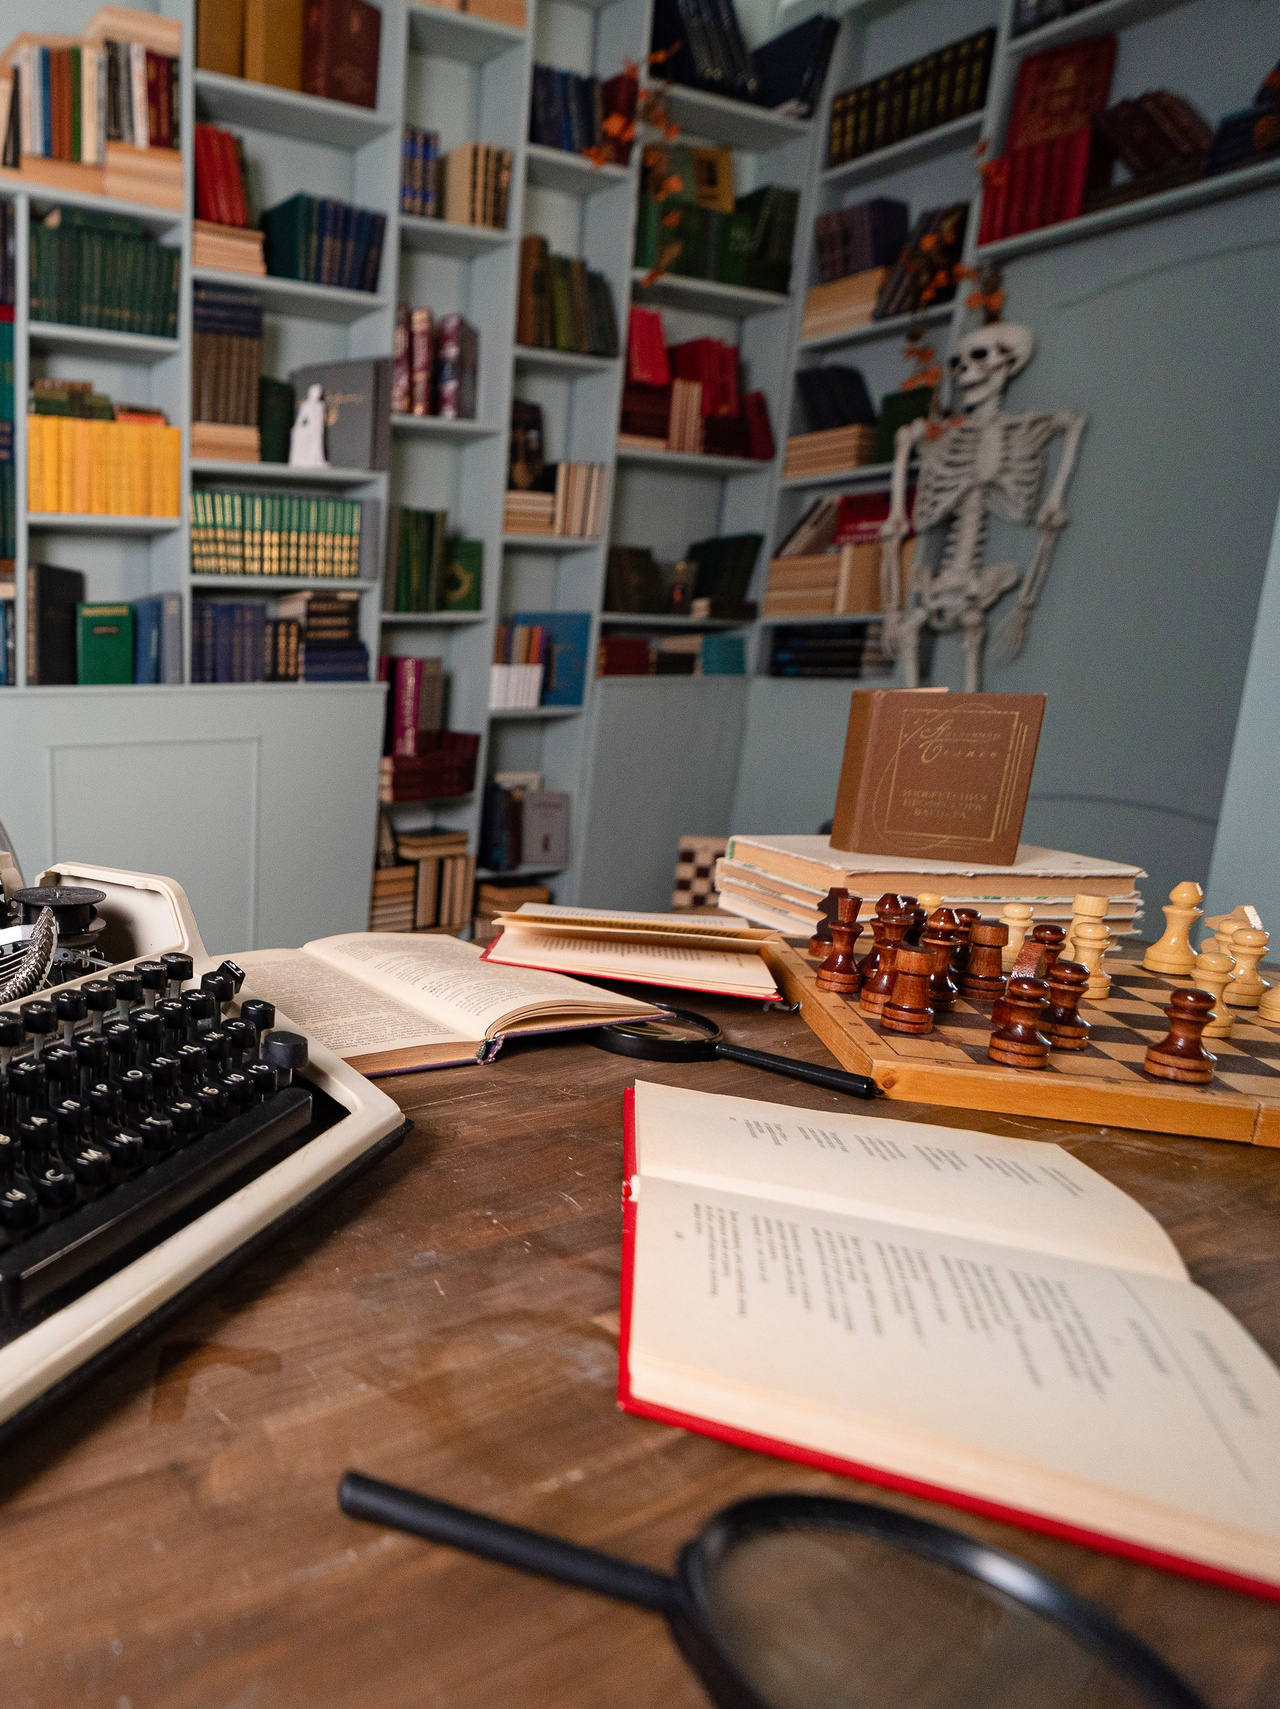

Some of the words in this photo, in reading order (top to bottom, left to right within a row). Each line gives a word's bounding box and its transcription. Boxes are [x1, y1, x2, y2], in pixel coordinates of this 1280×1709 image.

[111, 1023, 129, 1032] Ш
[205, 1031, 224, 1040] Ж
[50, 1048, 70, 1057] Н
[19, 1062, 36, 1071] Е
[126, 1069, 144, 1079] О
[227, 1073, 245, 1082] Ю
[95, 1083, 109, 1092] Р
[202, 1086, 219, 1095] Б
[61, 1099, 81, 1110] П
[30, 1116, 48, 1126] А
[114, 1133, 132, 1145] И
[81, 1148, 103, 1162] М
[45, 1168, 65, 1182] С
[5, 1188, 27, 1201] Ч
